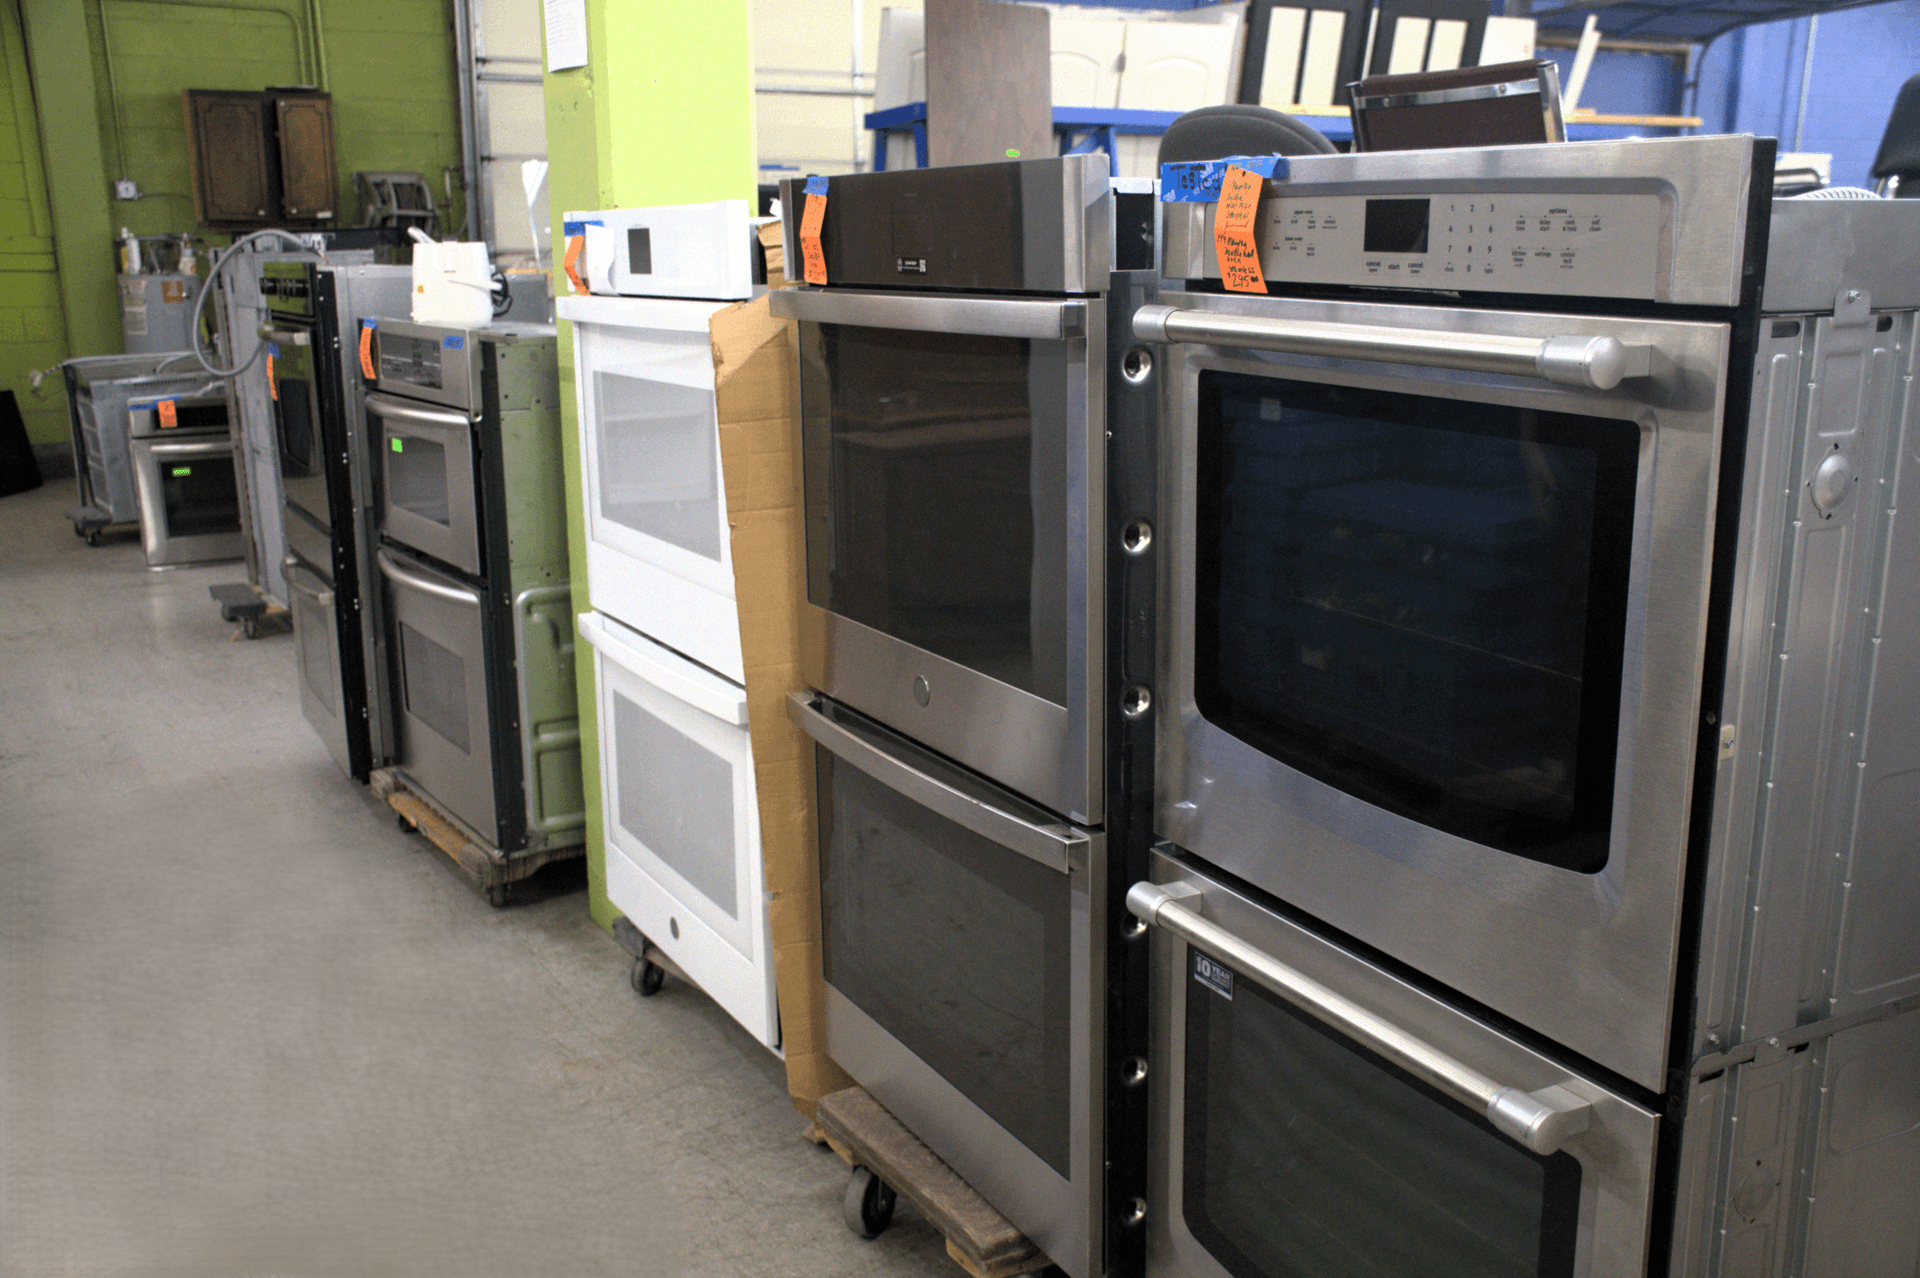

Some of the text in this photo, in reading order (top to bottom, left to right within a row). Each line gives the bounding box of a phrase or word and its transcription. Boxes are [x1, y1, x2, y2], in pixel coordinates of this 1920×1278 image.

[1450, 204, 1454, 212] 1
[1470, 204, 1474, 212] 2
[1490, 204, 1494, 212] 3
[1448, 225, 1453, 233] 4
[1469, 225, 1473, 233] 5
[1488, 225, 1493, 233] 6
[1448, 244, 1452, 253] 7
[1468, 245, 1472, 253] 8
[1488, 245, 1492, 254] 9
[1466, 264, 1471, 272] 0
[1196, 956, 1230, 980] 10 YEAR
